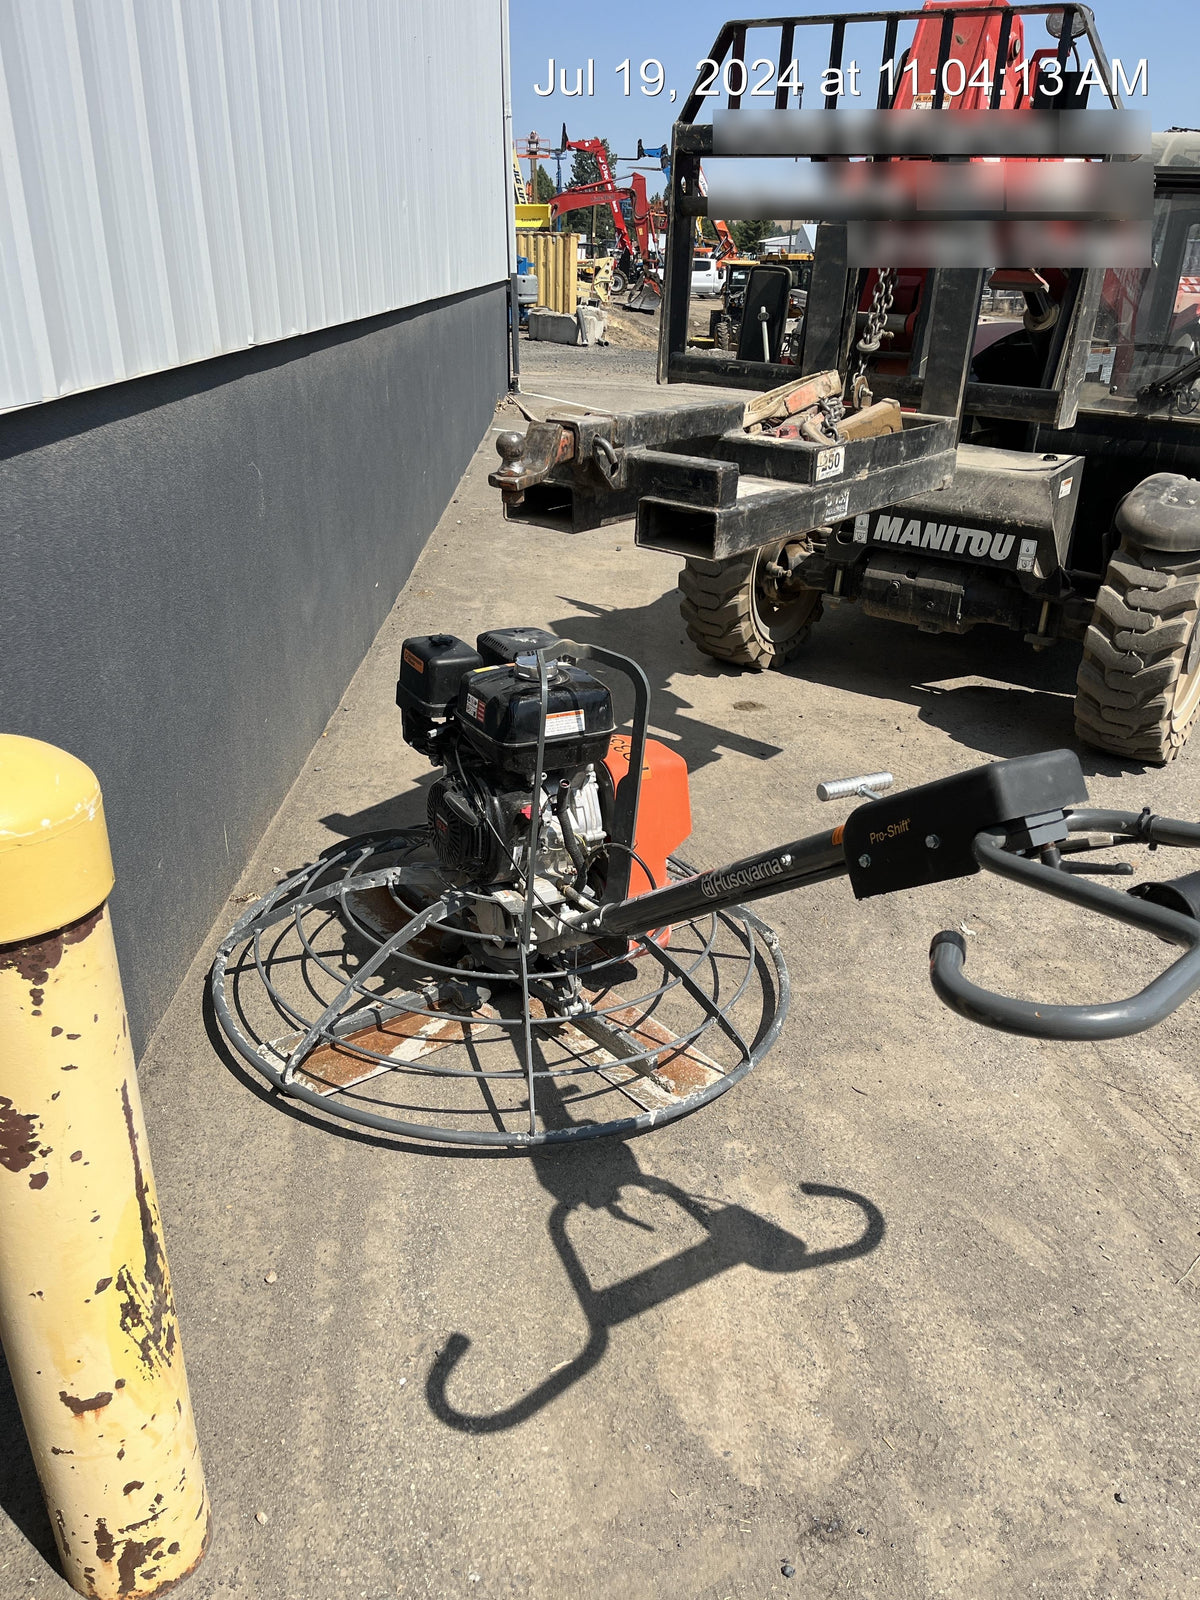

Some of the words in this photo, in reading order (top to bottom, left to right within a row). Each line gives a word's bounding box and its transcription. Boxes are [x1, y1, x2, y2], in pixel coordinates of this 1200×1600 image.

[873, 515, 1016, 561] MANITOU
[869, 818, 910, 845] Pro-Shift
[715, 857, 783, 893] Husqvarna
